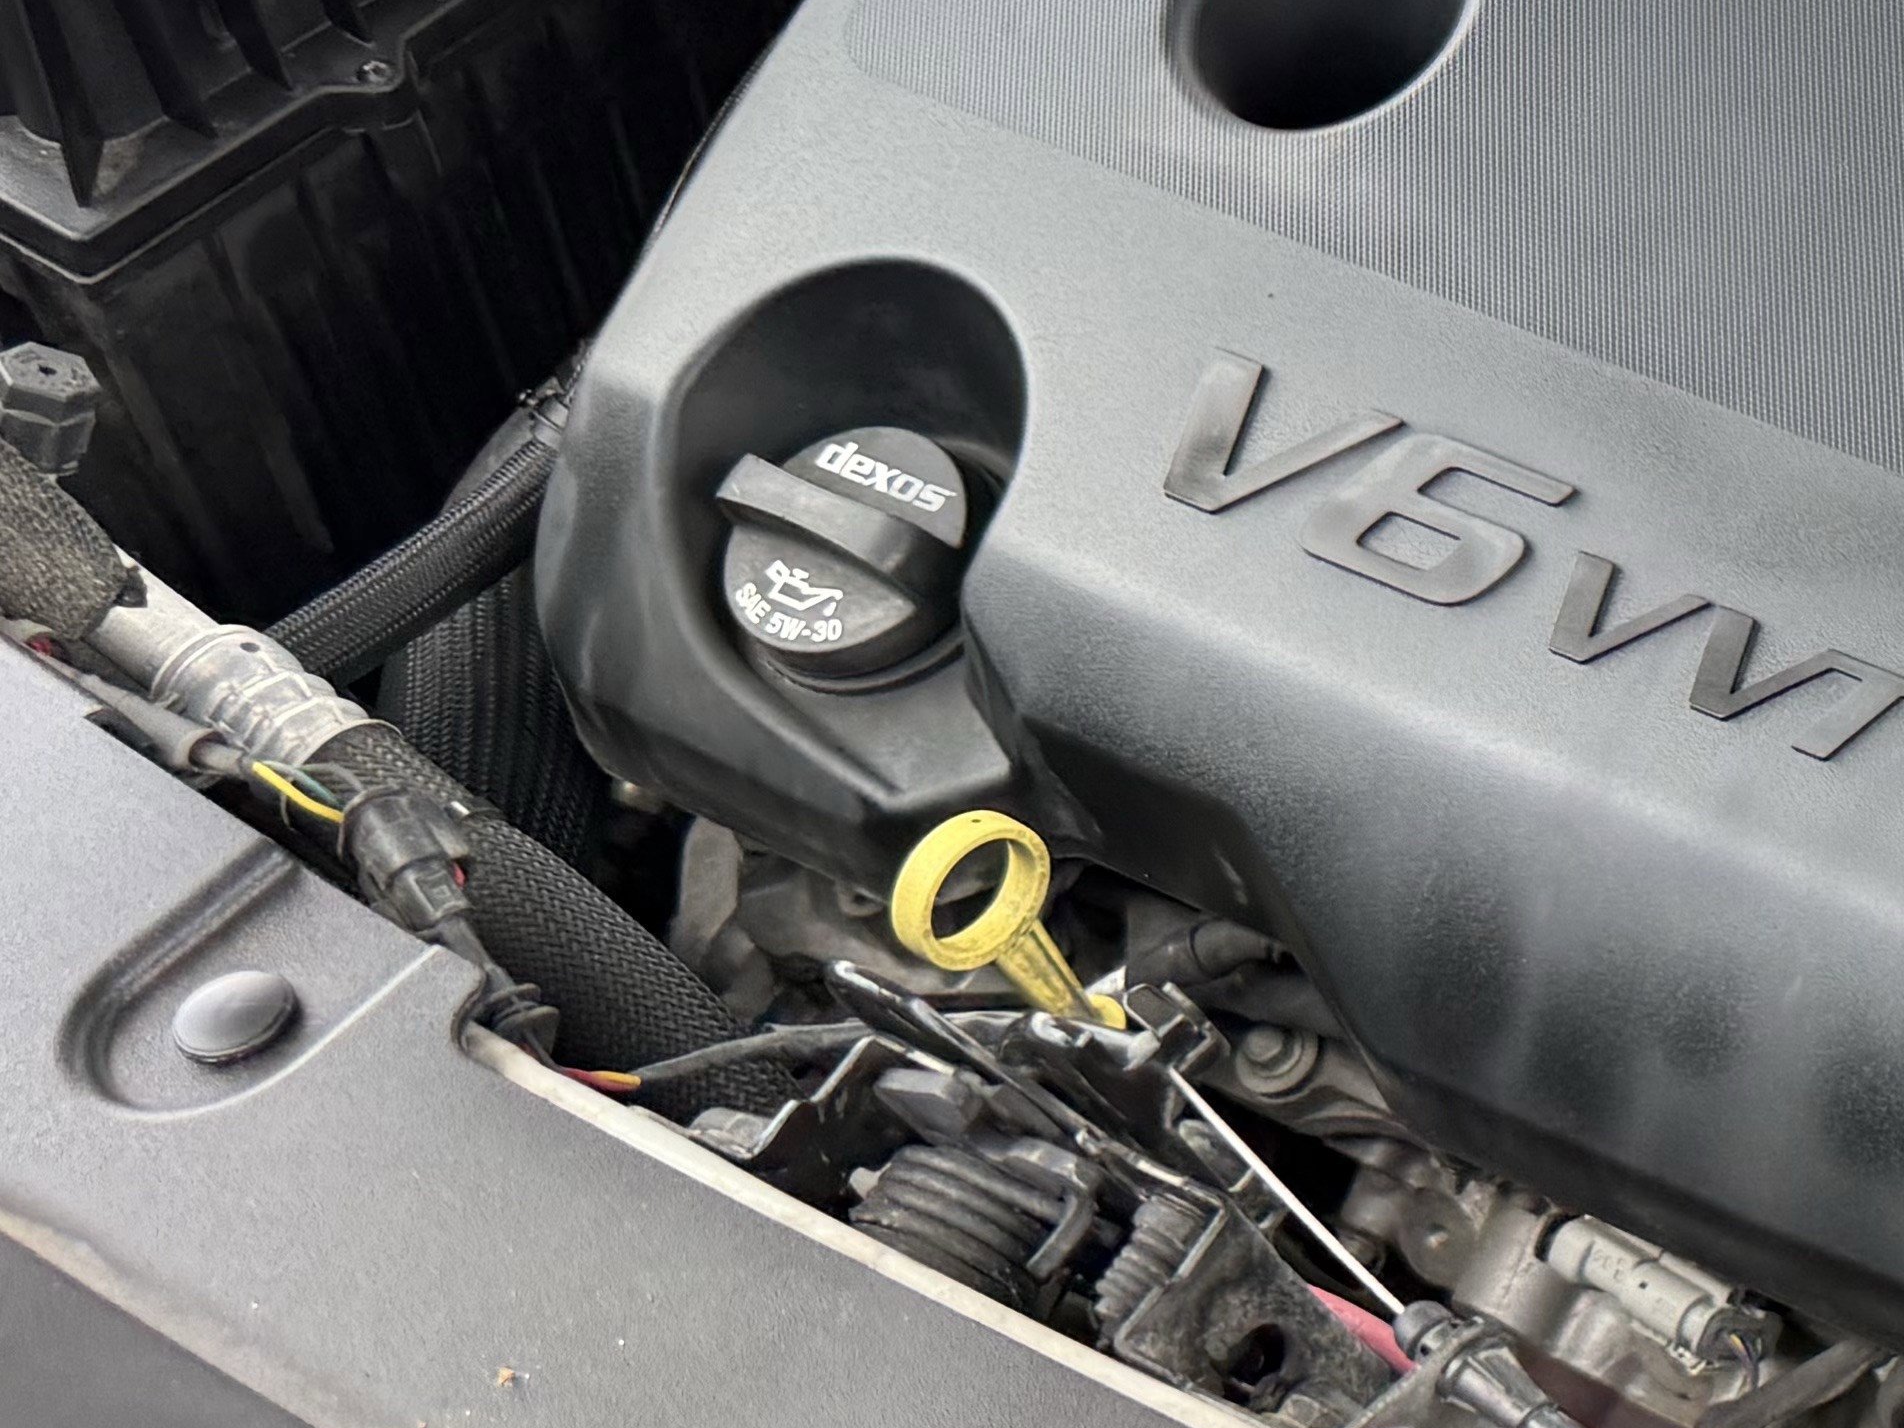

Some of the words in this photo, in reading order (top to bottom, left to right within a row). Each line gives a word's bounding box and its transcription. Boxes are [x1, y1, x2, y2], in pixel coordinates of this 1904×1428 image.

[815, 441, 958, 513] dexos
[1163, 347, 1576, 606] V6
[735, 583, 771, 625] SAE
[765, 614, 843, 642] 5W-30
